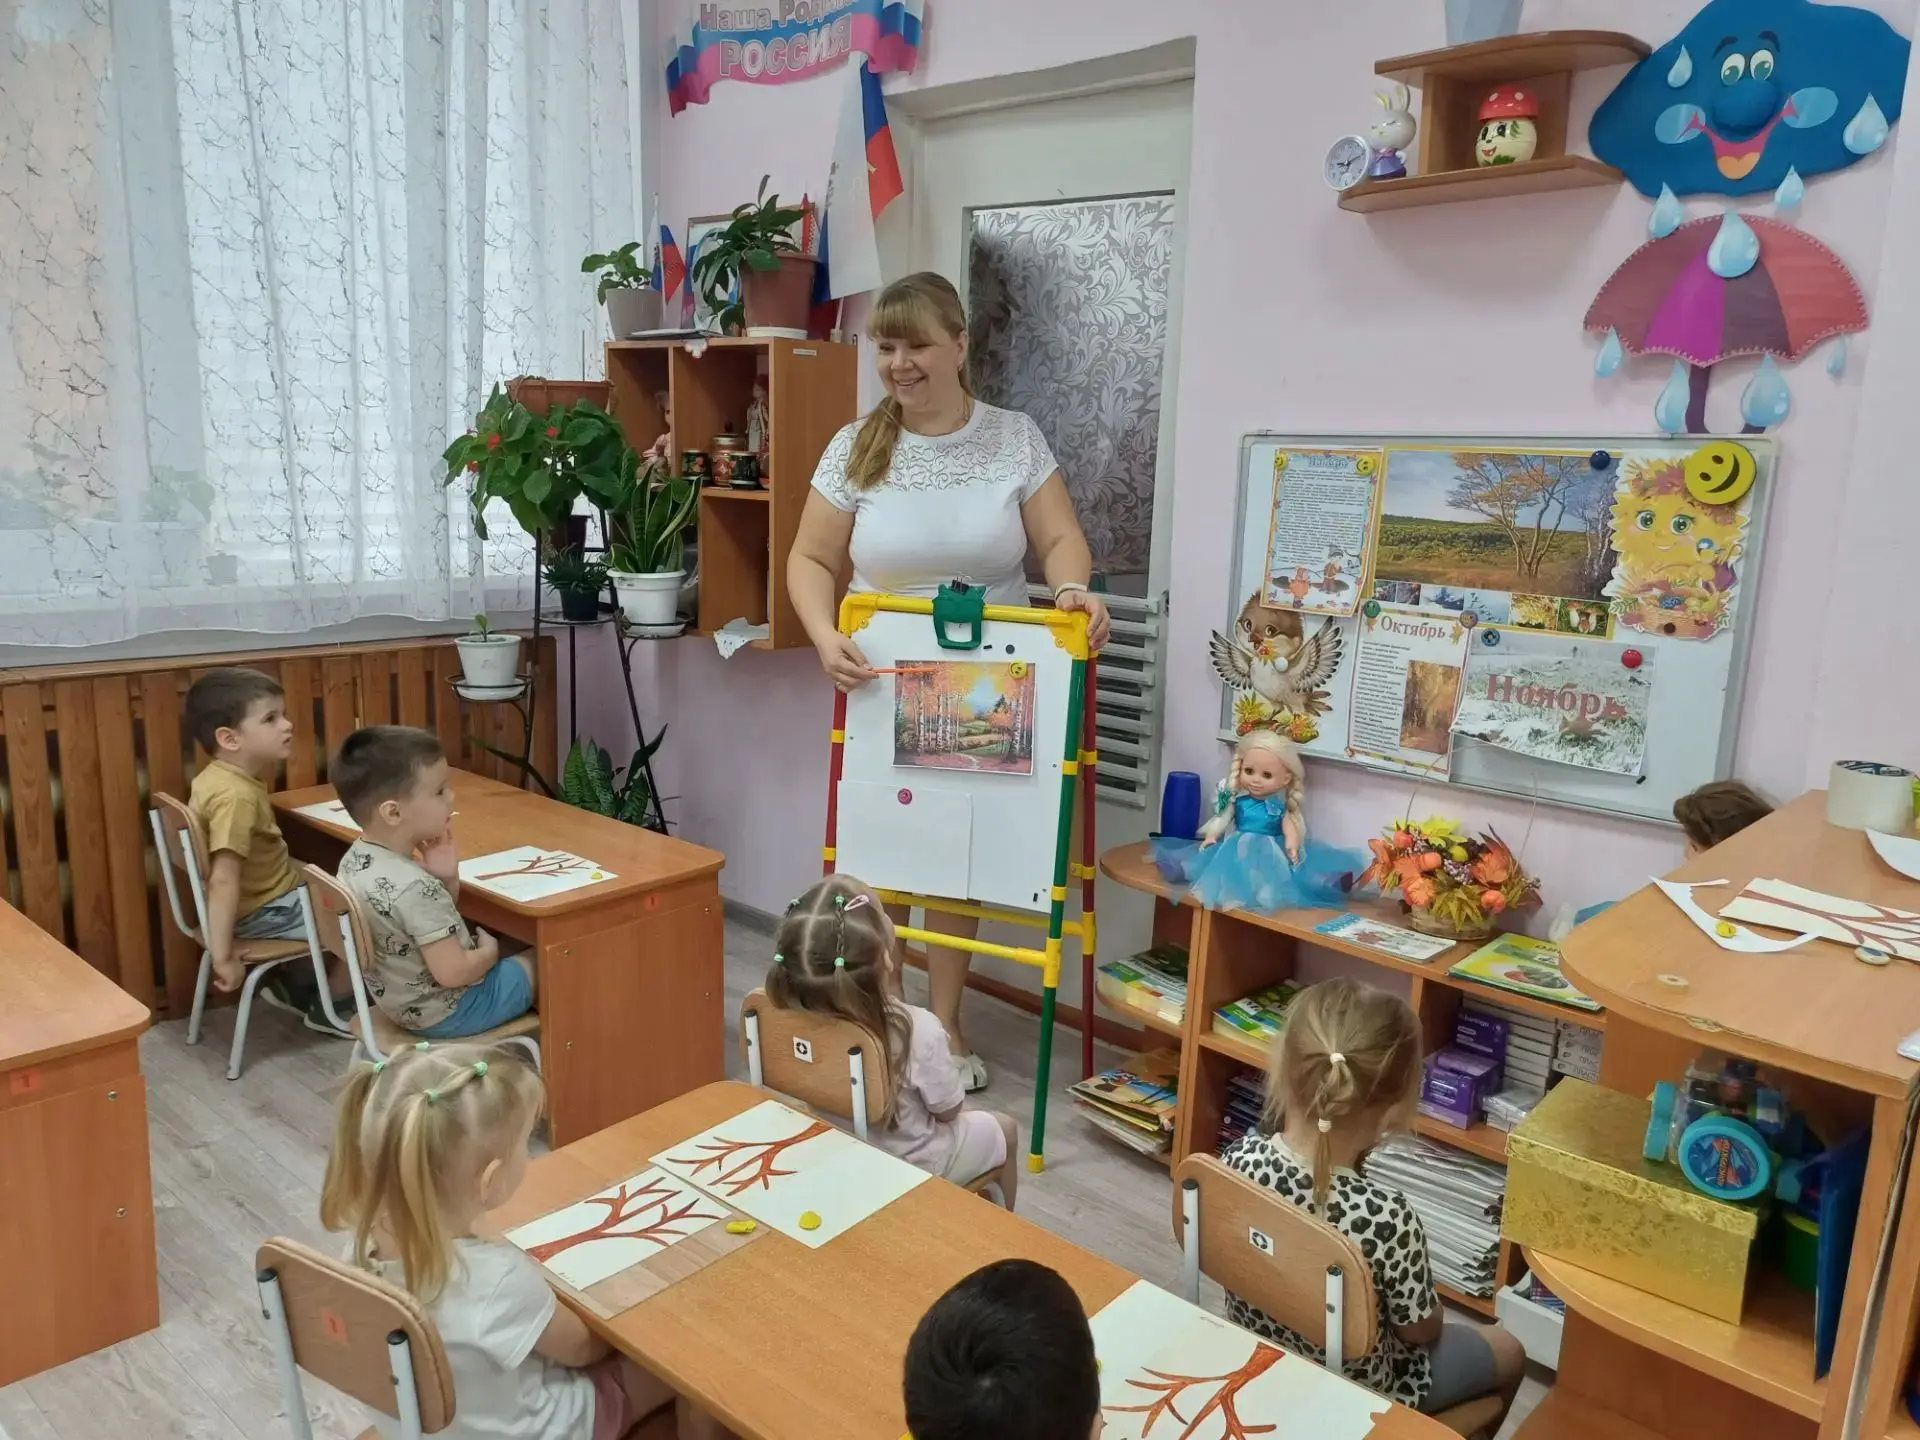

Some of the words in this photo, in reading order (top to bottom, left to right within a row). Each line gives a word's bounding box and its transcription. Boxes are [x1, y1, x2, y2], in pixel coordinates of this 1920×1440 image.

[700, 3, 772, 32] Наша
[720, 13, 852, 78] РОССИЯ
[1380, 615, 1447, 641] Октябрь
[1486, 672, 1628, 722] Ноябрь
